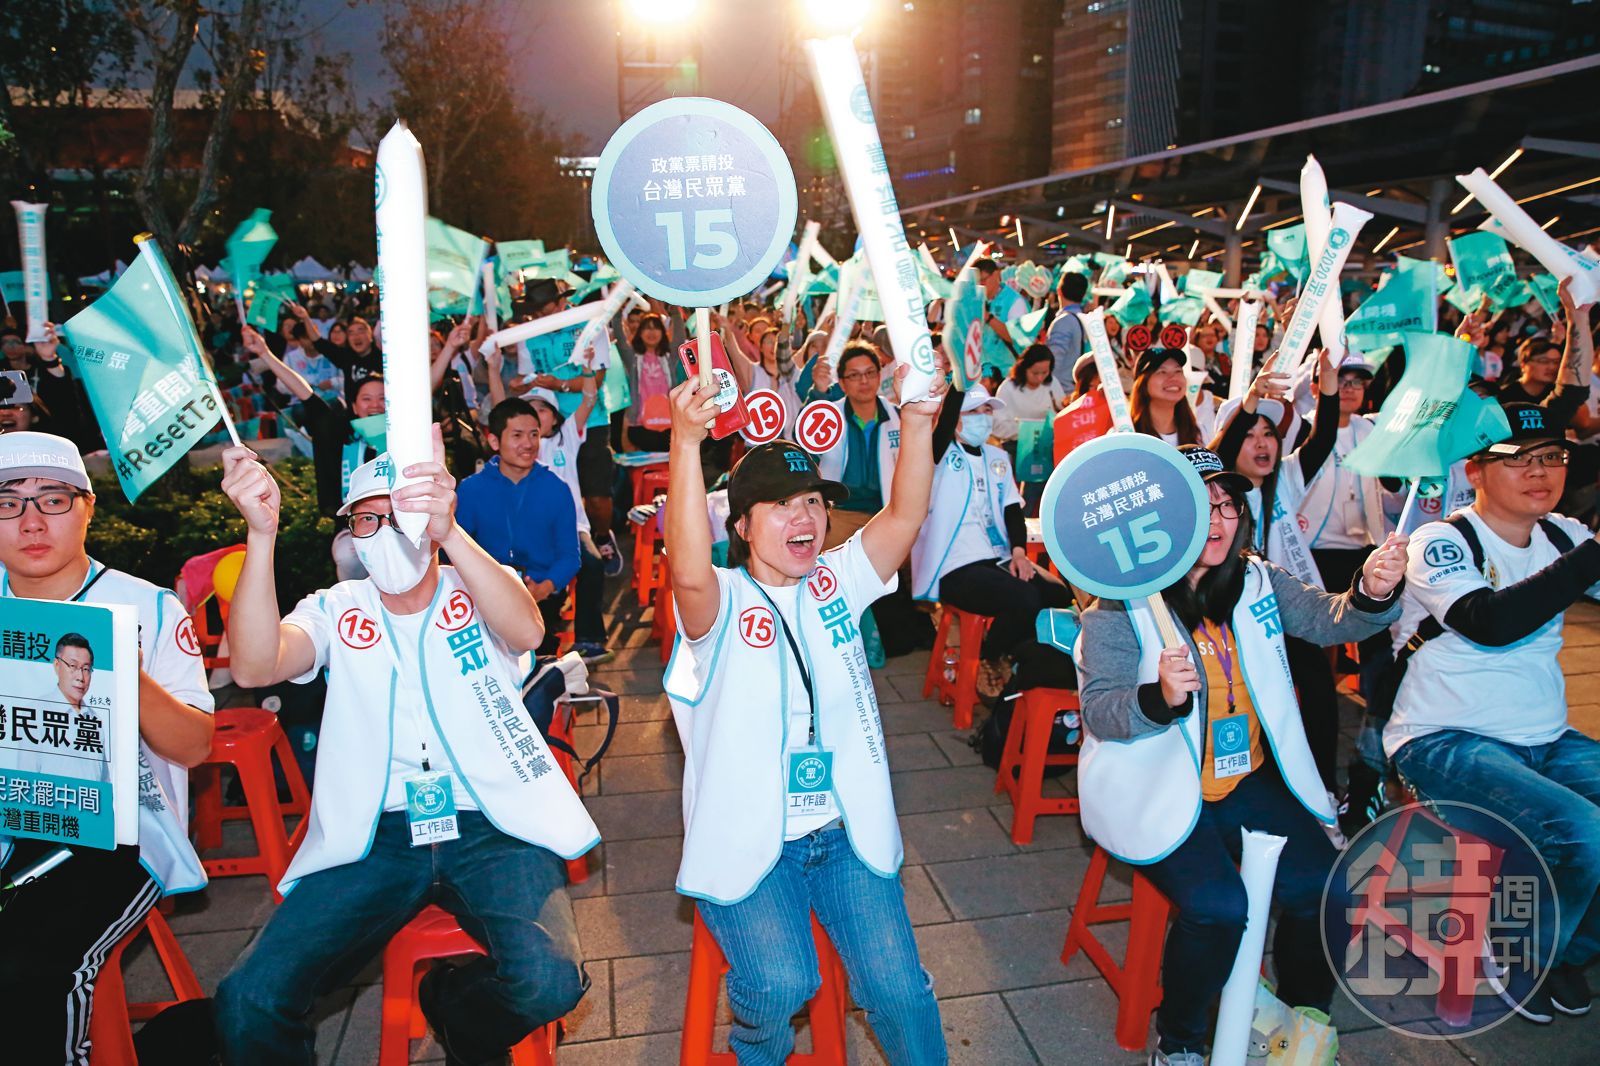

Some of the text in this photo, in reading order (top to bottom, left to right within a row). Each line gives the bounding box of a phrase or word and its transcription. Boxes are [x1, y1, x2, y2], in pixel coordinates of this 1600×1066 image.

[651, 154, 735, 174] 政黨票請投
[642, 175, 747, 201] 台灣民眾黨
[655, 209, 739, 271] 15
[1519, 409, 1545, 430] 眾
[784, 451, 812, 472] 眾
[1081, 483, 1165, 529] 台灣民眾黨
[1082, 470, 1149, 506] 政黨票請投
[1097, 511, 1173, 575] 15
[818, 596, 859, 649] 眾
[2, 630, 51, 662] 請投
[446, 621, 490, 677] 眾
[483, 674, 553, 780] 台灣民眾黨
[841, 652, 882, 765] TAIWAN PEOPLE'S PARTY
[471, 680, 532, 784] TAIWAN PEOPLE'S PARTY
[1217, 754, 1248, 771] 工作證
[0, 775, 100, 814] 衆擺中間
[790, 794, 827, 808] 工作證
[414, 818, 455, 837] 工作證
